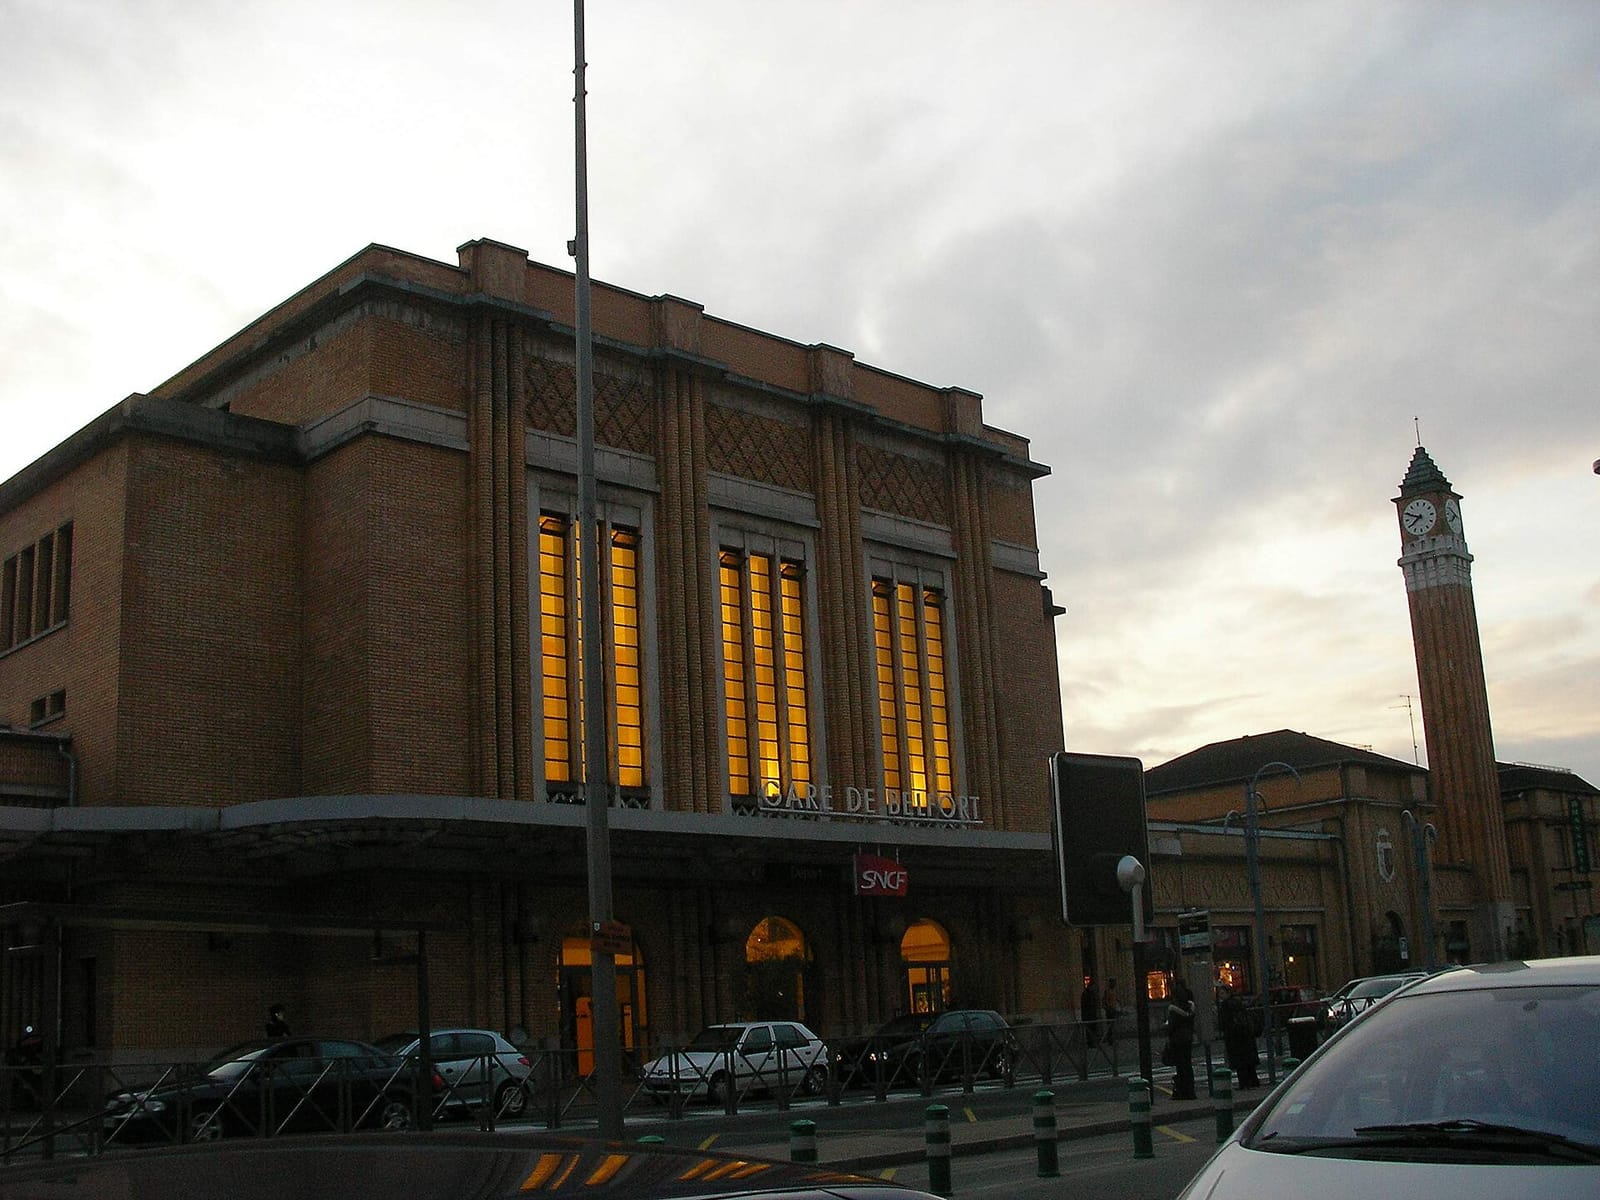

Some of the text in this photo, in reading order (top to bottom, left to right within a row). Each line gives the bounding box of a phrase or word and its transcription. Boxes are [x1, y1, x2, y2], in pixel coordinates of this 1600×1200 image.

[761, 781, 980, 819] GARE DE BELFORT
[861, 870, 907, 890] SNCF
